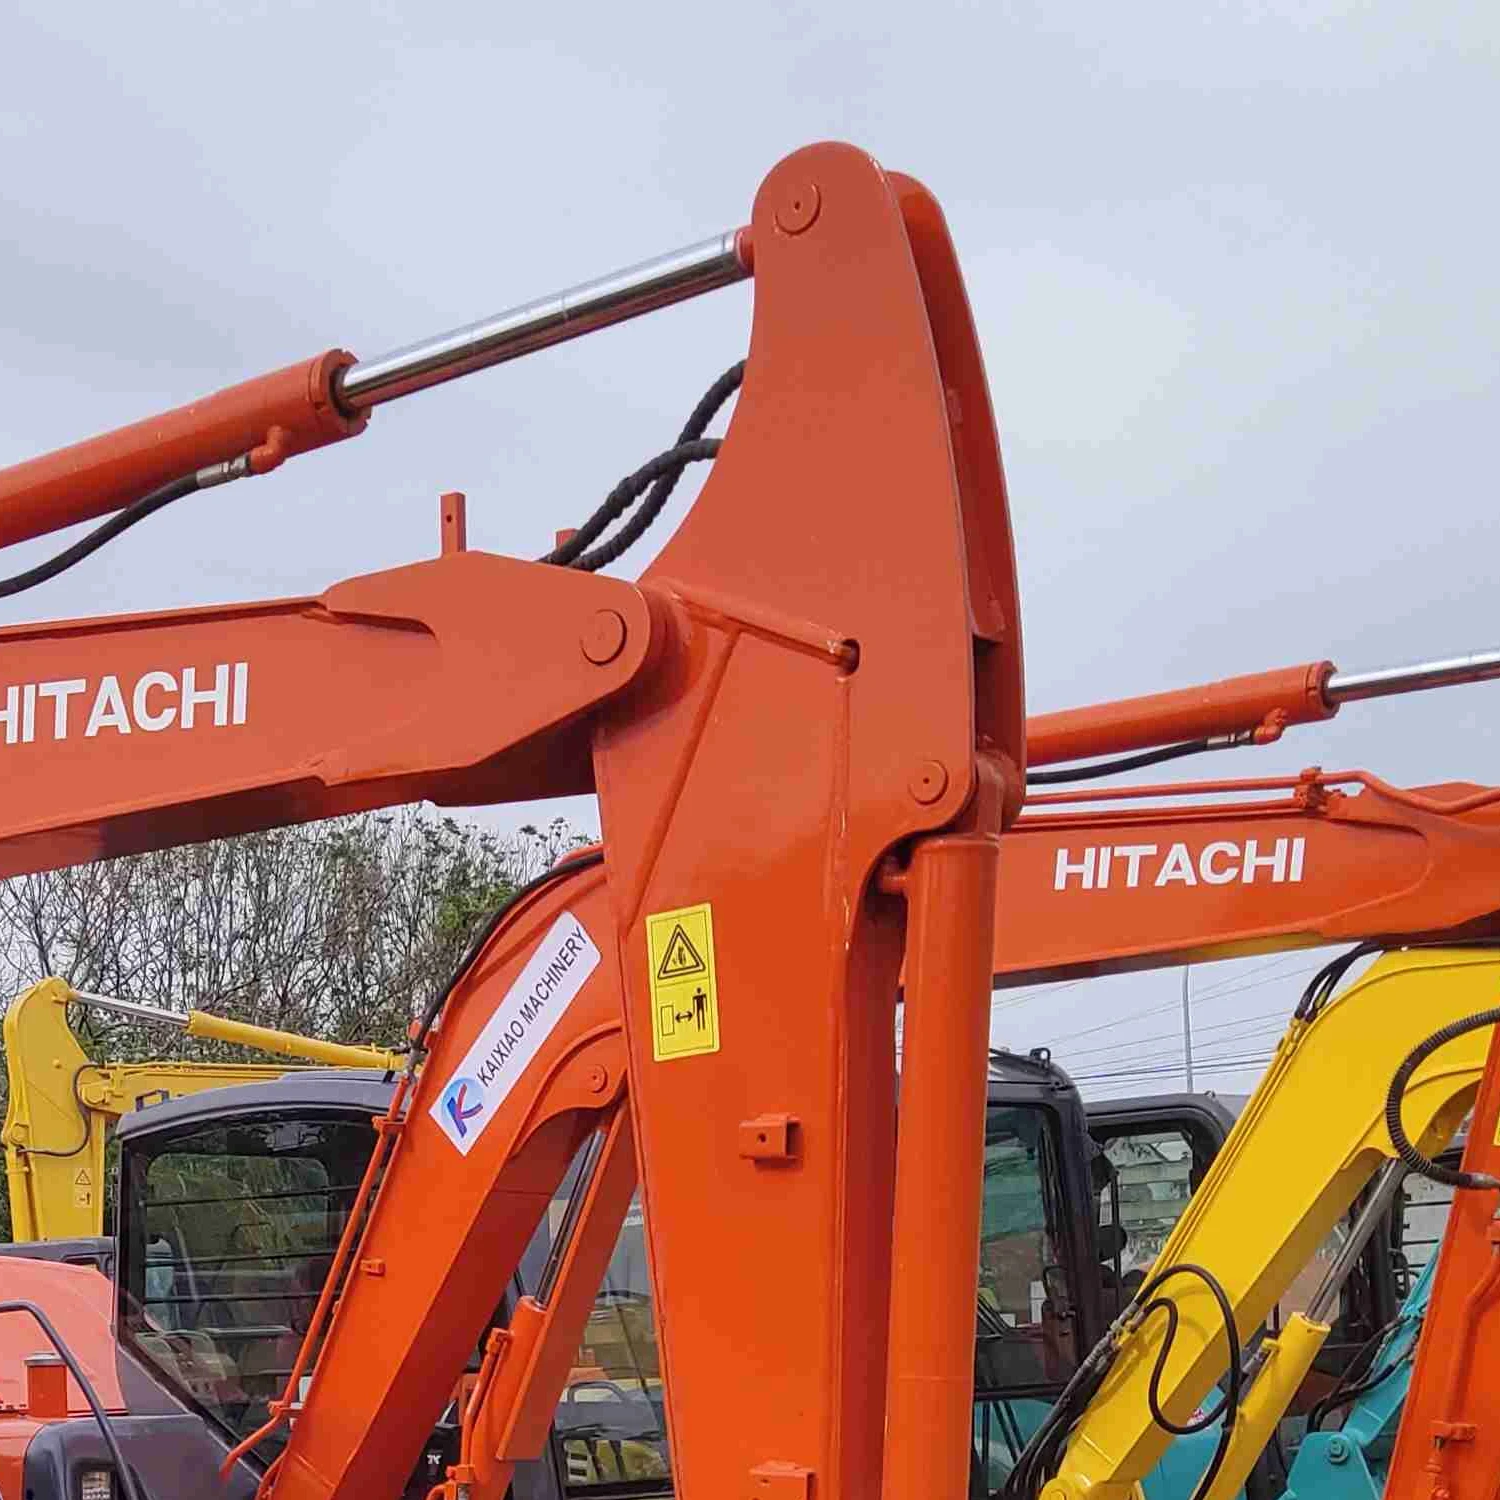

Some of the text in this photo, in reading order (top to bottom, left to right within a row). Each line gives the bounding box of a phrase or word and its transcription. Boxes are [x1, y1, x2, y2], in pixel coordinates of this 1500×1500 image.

[1054, 838, 1306, 890] HITACHI
[477, 1020, 525, 1088] KAIXIAO
[519, 926, 587, 1025] MACHINERY
